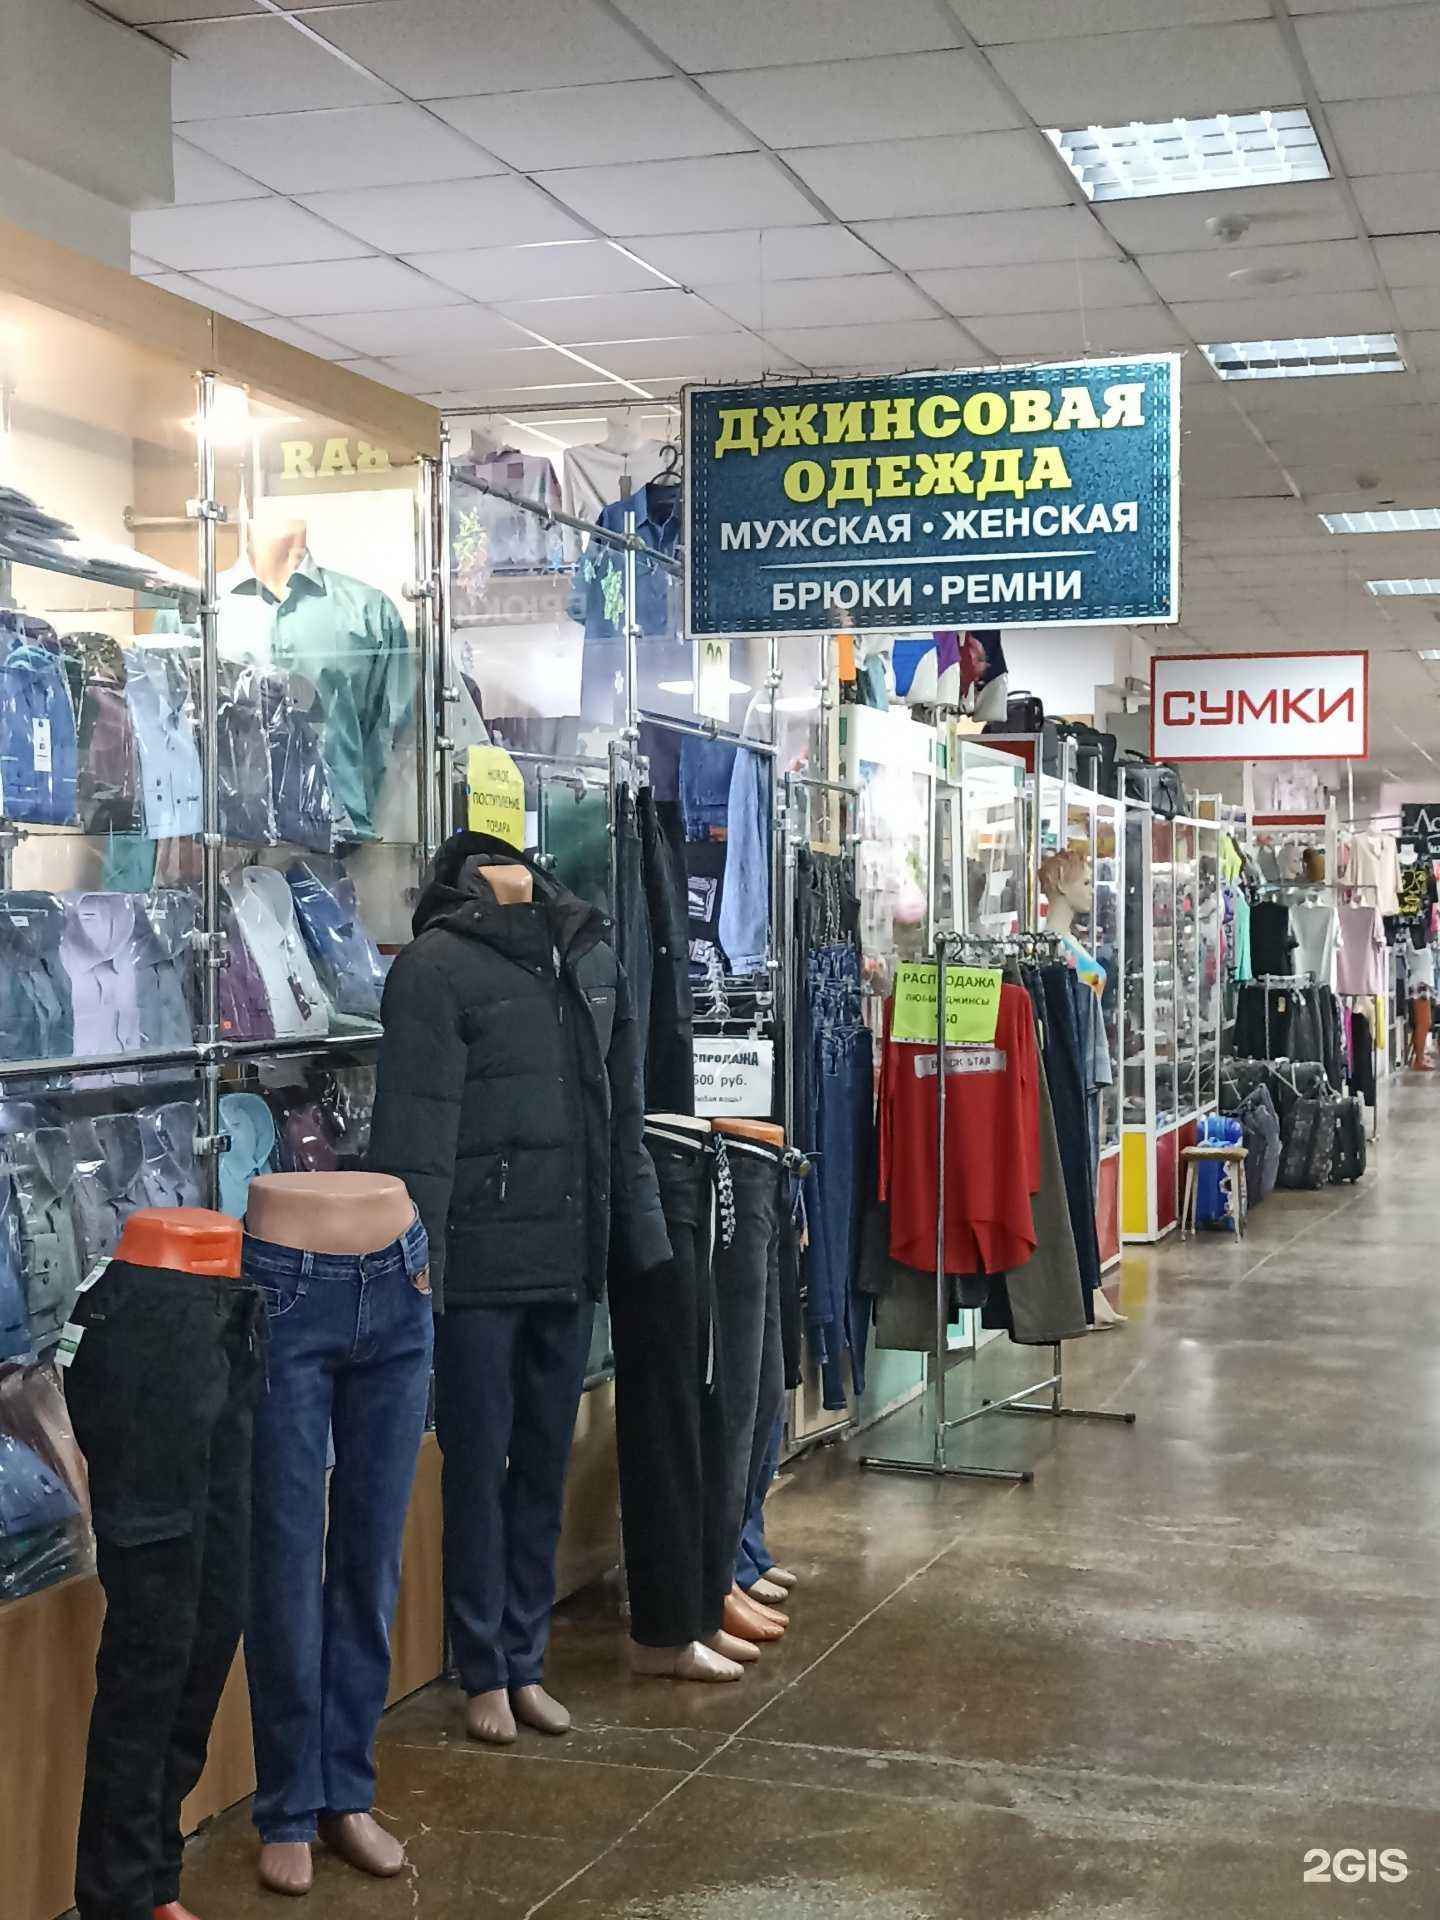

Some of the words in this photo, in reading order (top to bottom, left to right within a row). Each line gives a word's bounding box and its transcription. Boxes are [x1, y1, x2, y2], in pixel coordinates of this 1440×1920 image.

[714, 383, 1146, 459] ДЖИНСОВАЯ
[783, 446, 1073, 509] ОДЕЖДА
[720, 513, 912, 551] МУЖСКАЯ
[941, 501, 1138, 541] ЖЕНСКАЯ
[772, 577, 912, 611] БРЮКИ
[940, 570, 1082, 605] РЕМНИ
[1163, 687, 1355, 727] СУМКИ
[903, 972, 996, 989] РАСПОДАЖА
[720, 1073, 748, 1088] руб.
